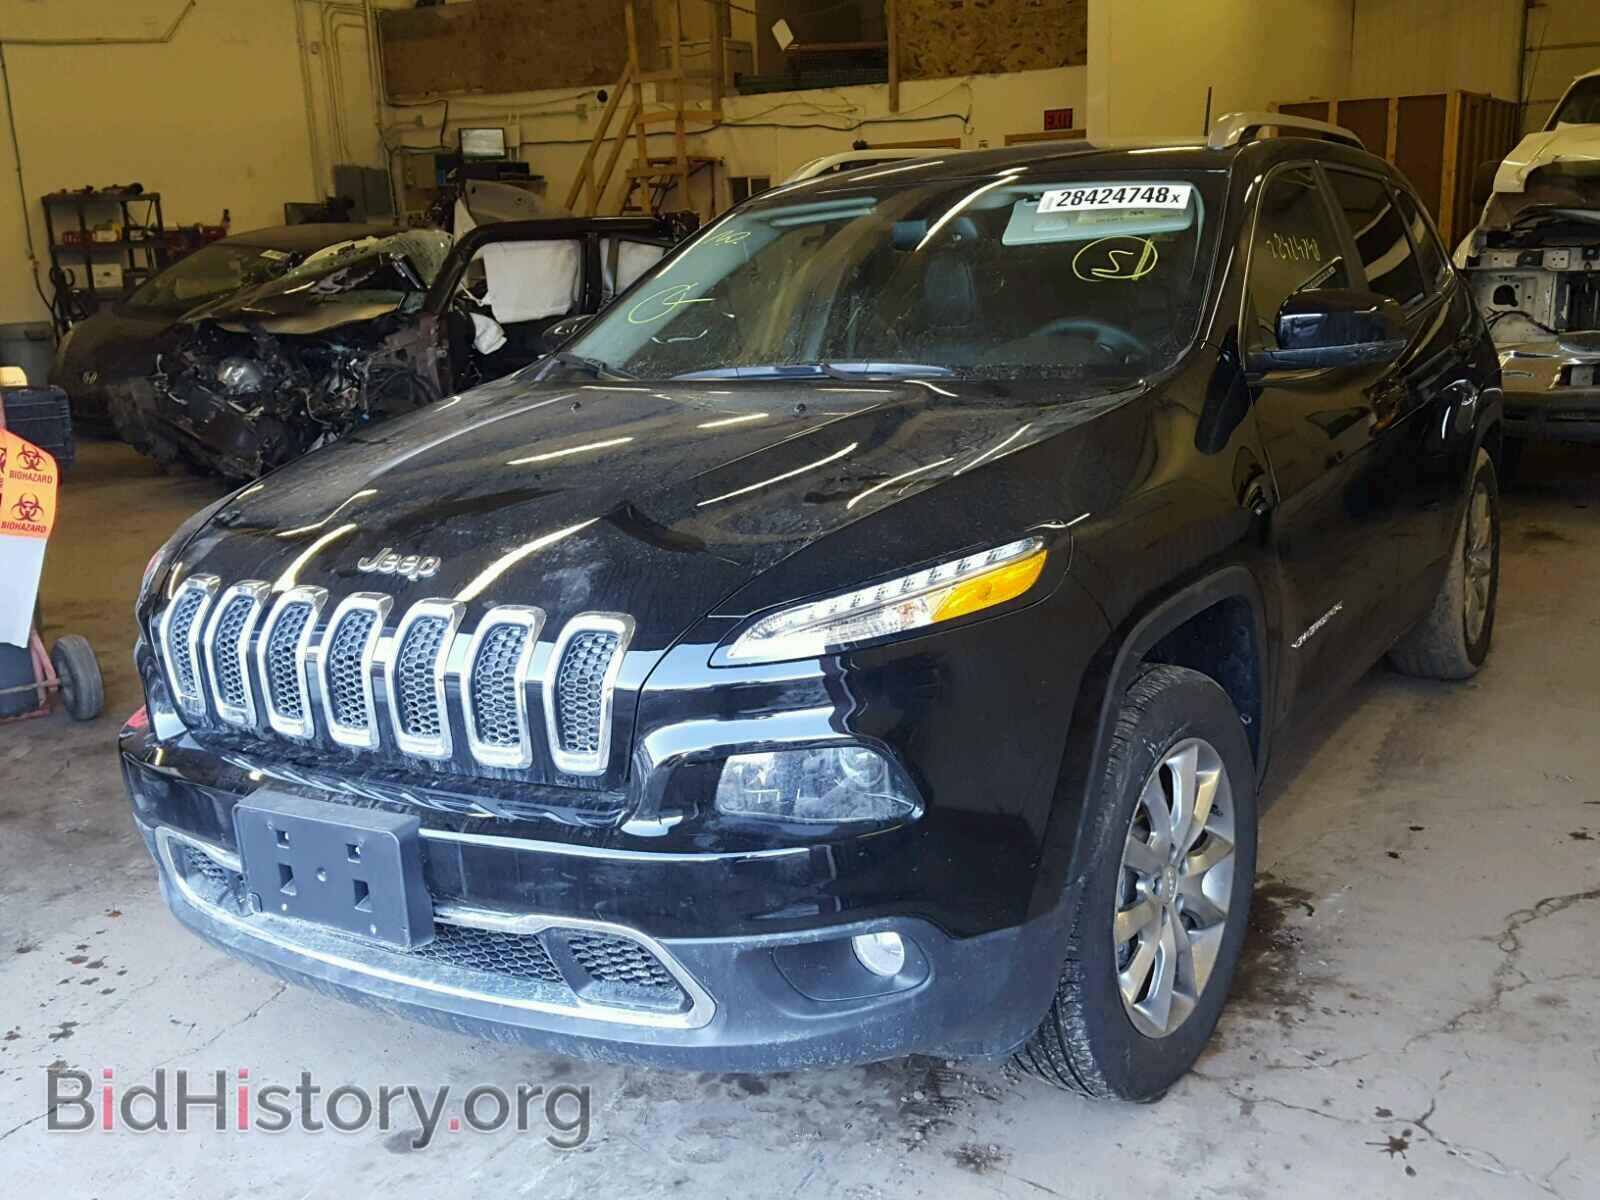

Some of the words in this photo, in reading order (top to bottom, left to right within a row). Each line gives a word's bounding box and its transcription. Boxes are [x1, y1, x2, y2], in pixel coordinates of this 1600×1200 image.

[1045, 109, 1072, 129] EXIT
[10, 470, 53, 484] BIOHAZARD
[1, 521, 47, 534] BIOHAZARD
[357, 547, 441, 582] Jeep
